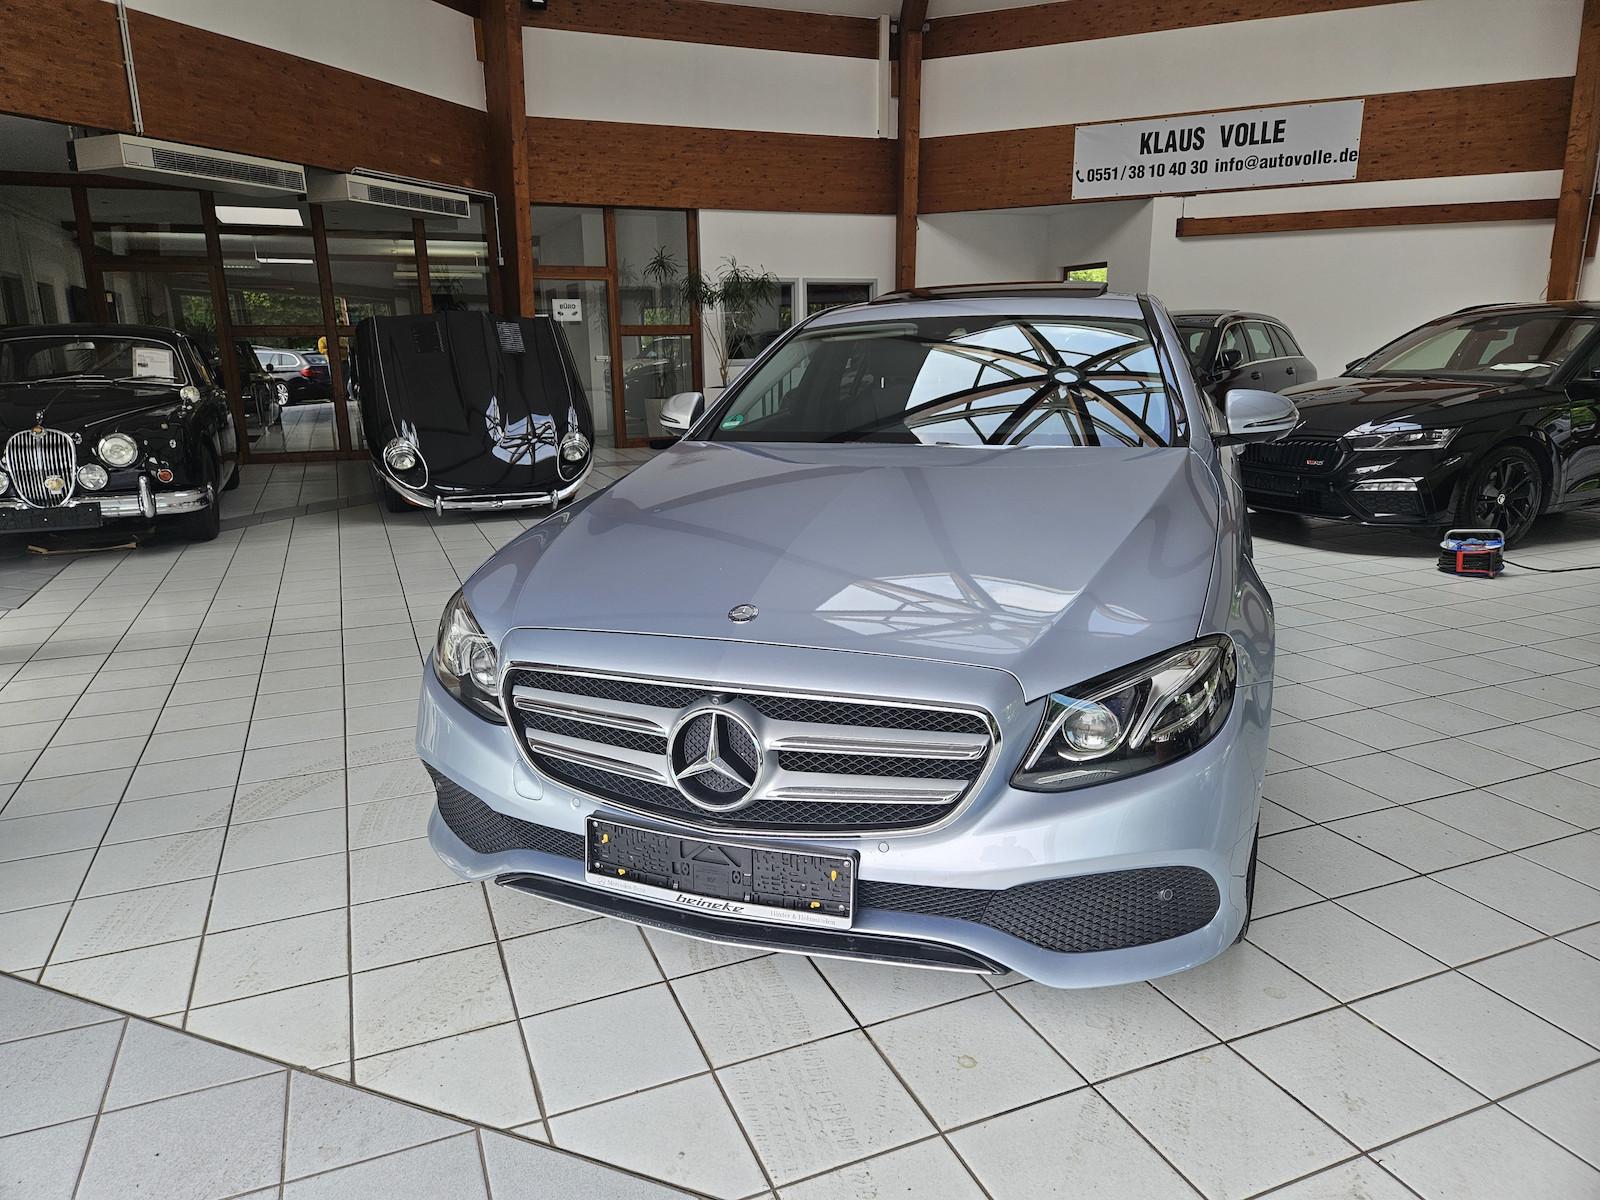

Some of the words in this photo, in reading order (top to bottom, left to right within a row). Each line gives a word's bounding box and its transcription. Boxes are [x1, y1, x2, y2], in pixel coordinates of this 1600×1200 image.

[1139, 126, 1205, 155] KLAUS
[1220, 119, 1286, 148] VOLLE
[1149, 163, 1165, 178] 10
[1168, 161, 1186, 177] 40
[1190, 159, 1208, 175] 30
[1214, 148, 1358, 173] info@autovolle.de
[559, 302, 576, 310] BÜRO
[676, 894, 744, 913] heineke
